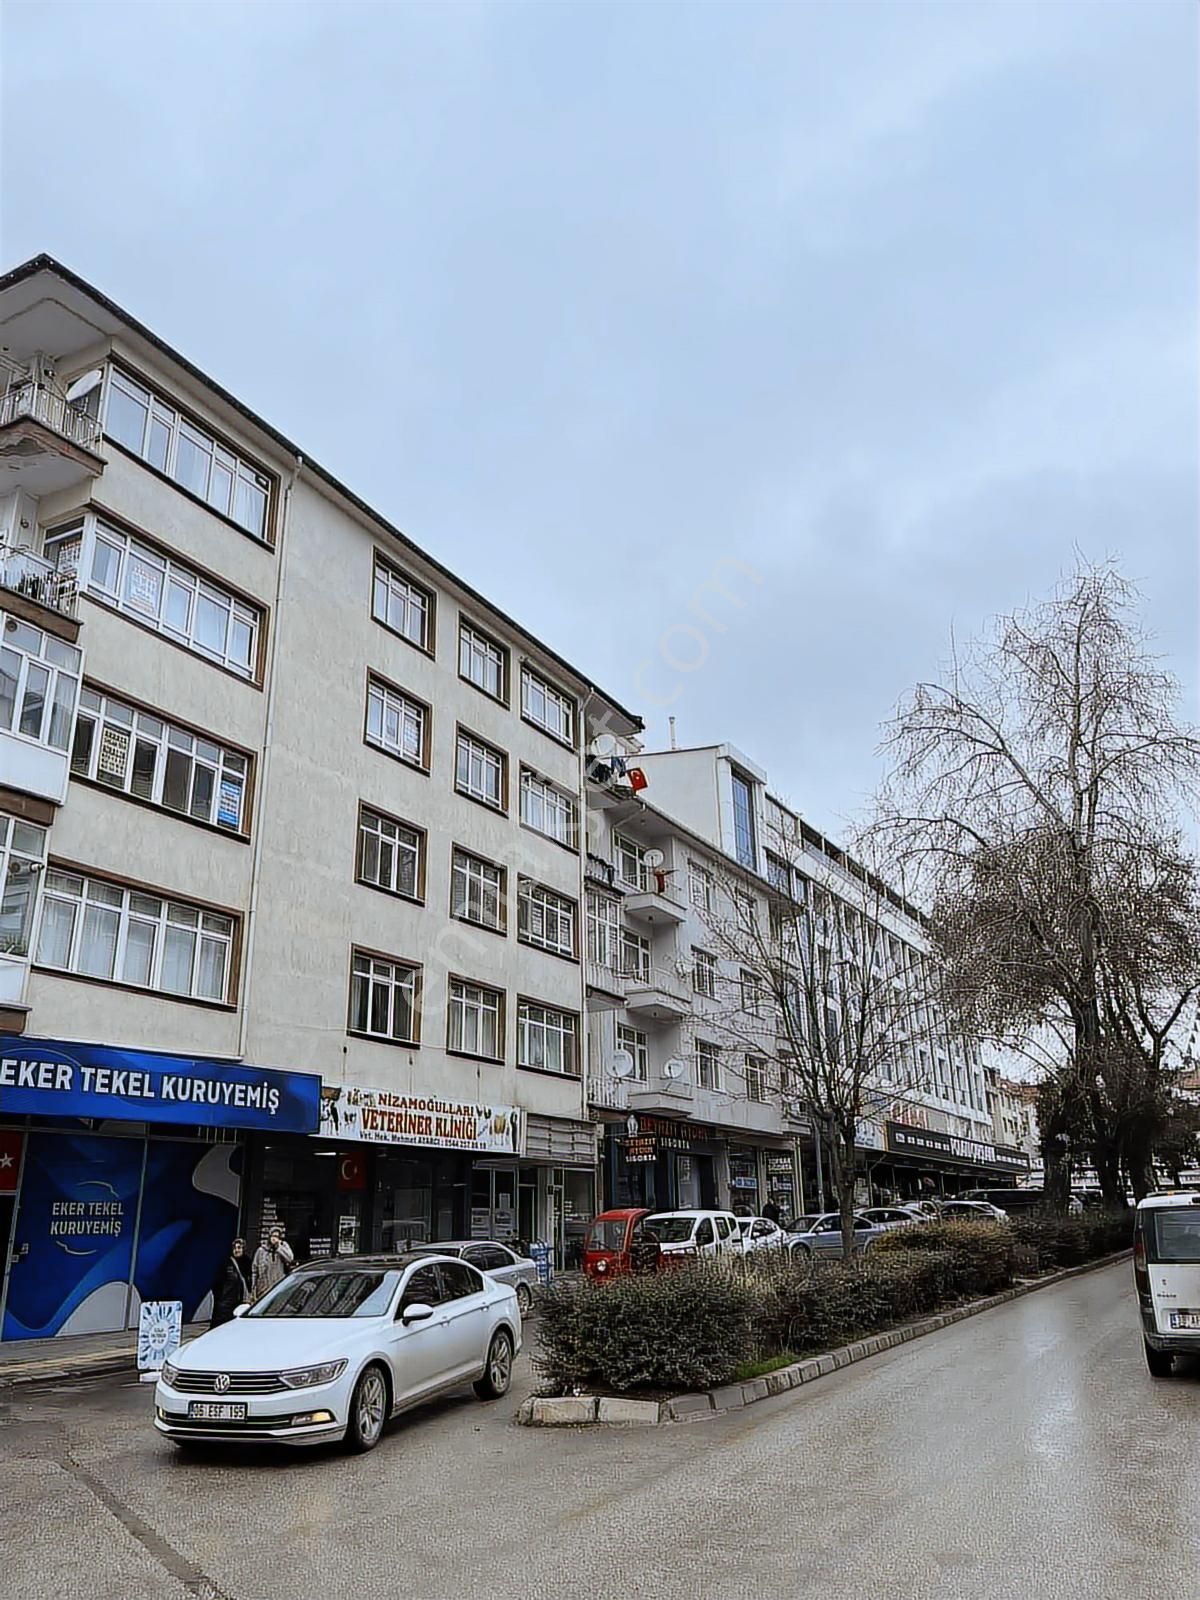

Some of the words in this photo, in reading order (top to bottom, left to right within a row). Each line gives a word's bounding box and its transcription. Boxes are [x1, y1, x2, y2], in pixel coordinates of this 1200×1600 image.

[0, 1058, 74, 1091] EKER
[81, 1066, 156, 1098] TEKEL
[161, 1075, 281, 1115] KURUYEMİŞ
[378, 1092, 475, 1118] NİZAMOĞULLARI
[361, 1107, 433, 1136] VETERİNER
[435, 1115, 478, 1141] KLİNİĞİ
[52, 1202, 85, 1216] EKER
[88, 1202, 124, 1216] TEKEL
[50, 1217, 122, 1238] KURUYEMİŞ
